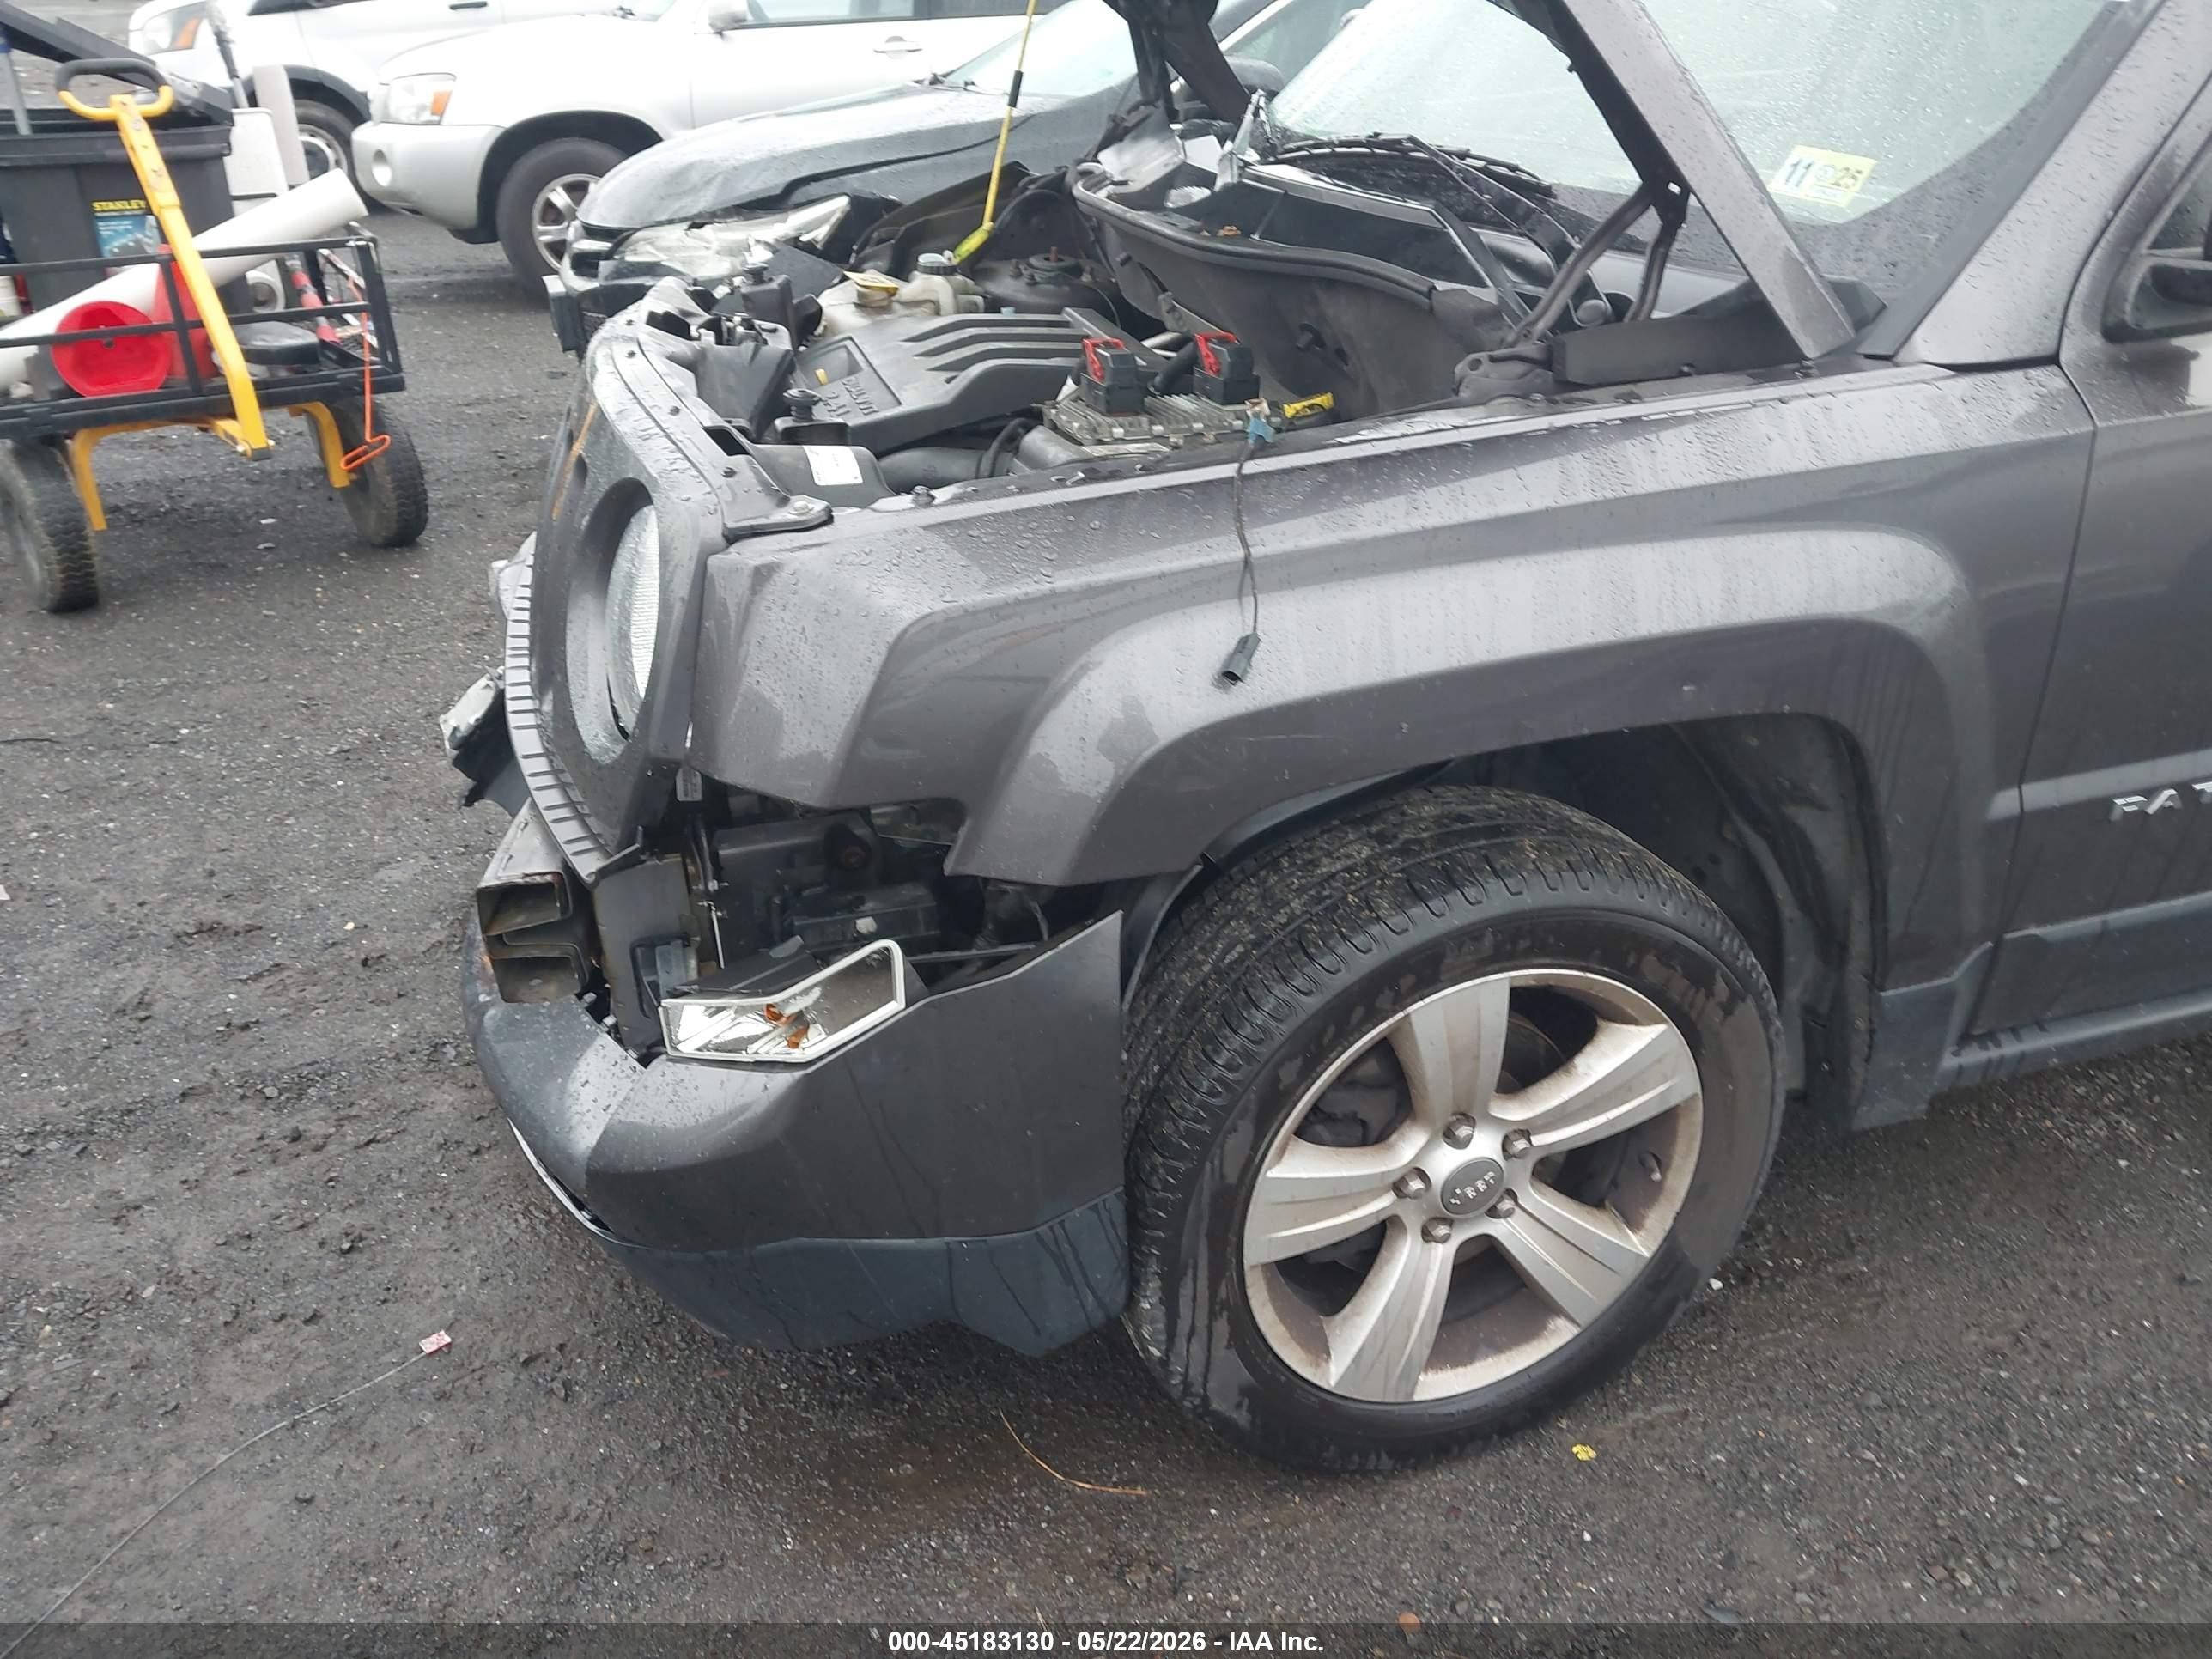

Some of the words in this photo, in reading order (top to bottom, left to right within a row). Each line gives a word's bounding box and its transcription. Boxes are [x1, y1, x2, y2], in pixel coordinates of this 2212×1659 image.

[1784, 157, 1814, 188] 11
[1830, 165, 1864, 191] 25
[92, 199, 147, 212] STANLEY
